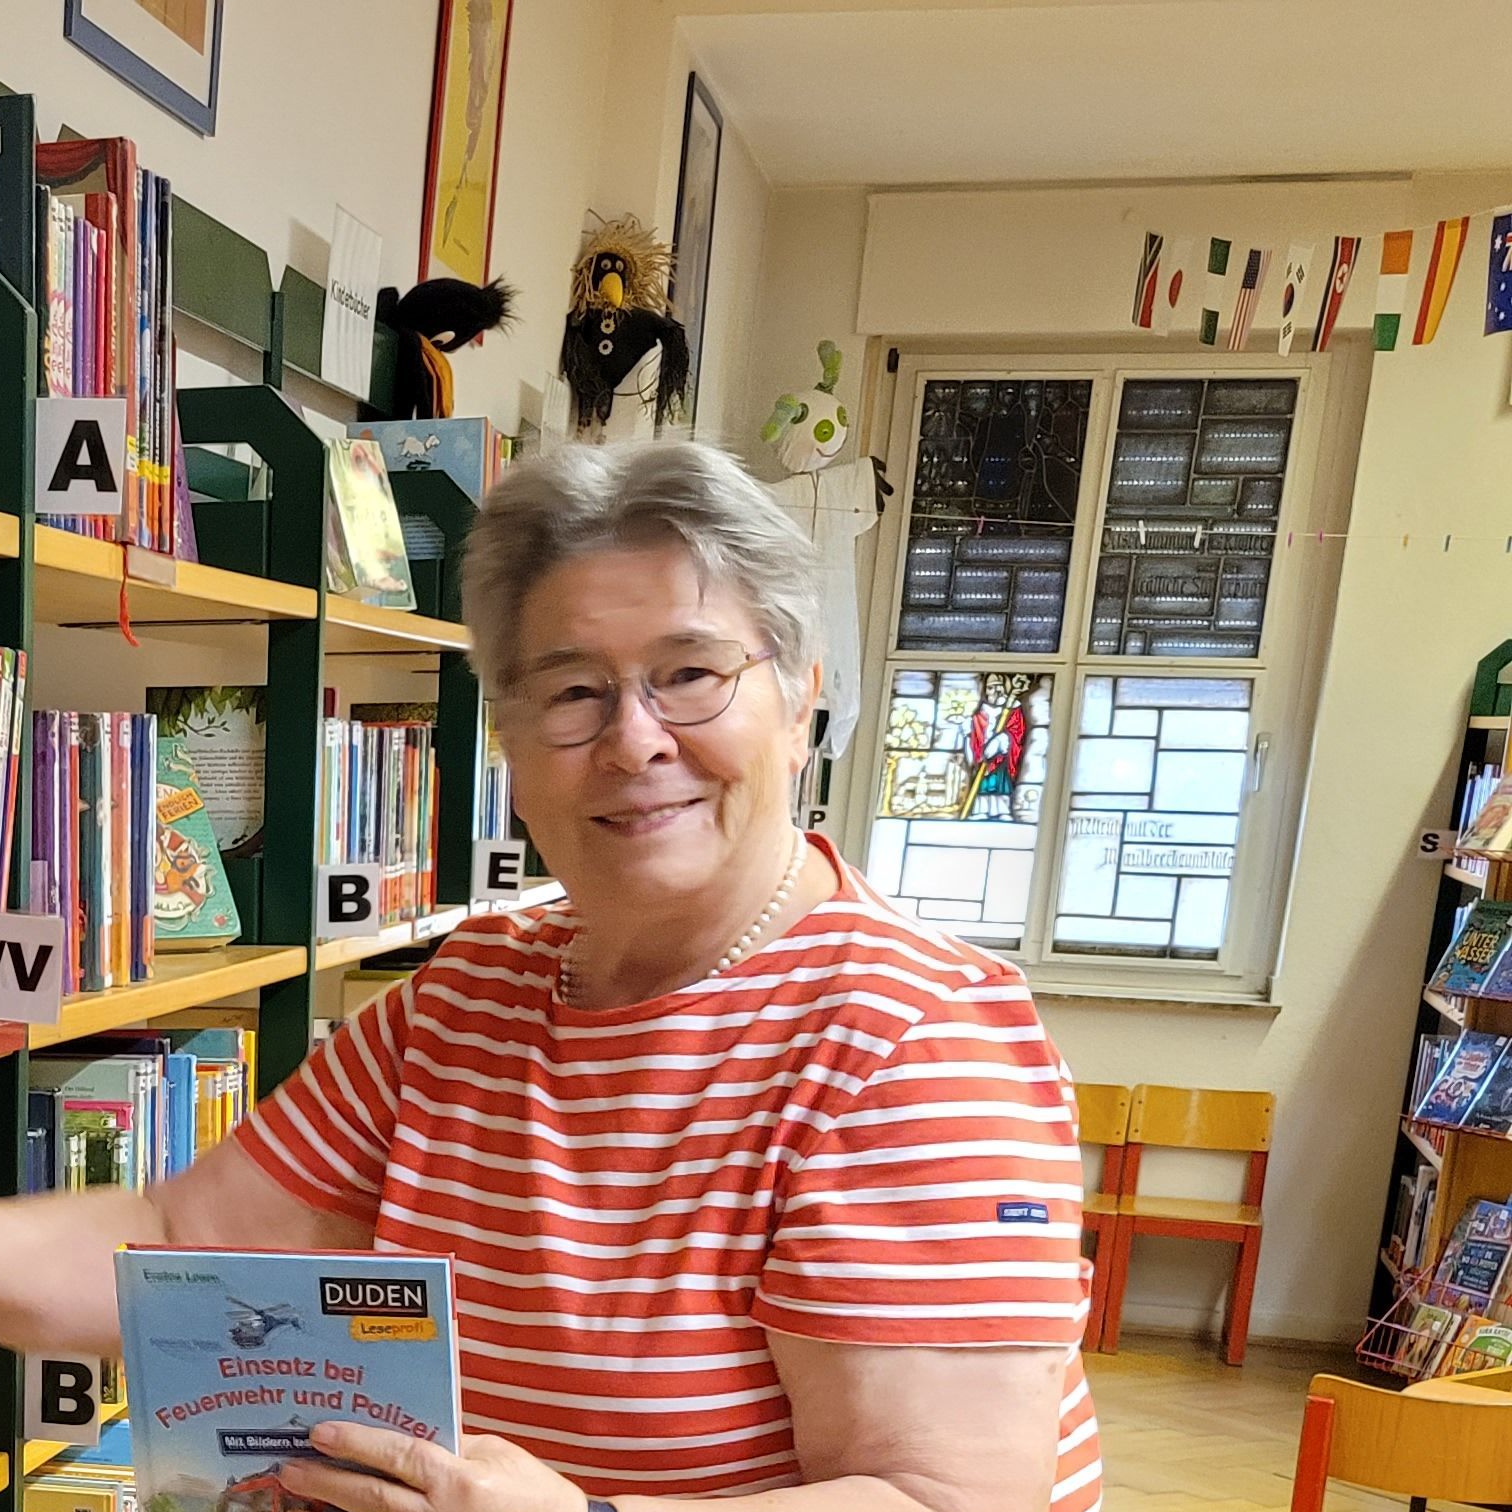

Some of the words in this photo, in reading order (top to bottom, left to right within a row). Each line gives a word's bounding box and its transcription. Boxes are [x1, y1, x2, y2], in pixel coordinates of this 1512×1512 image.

[330, 277, 372, 320] Kinderbücher
[47, 419, 118, 492] A
[808, 810, 826, 829] P
[1420, 833, 1441, 853] S
[488, 852, 519, 889] E
[328, 875, 371, 922] B
[1463, 931, 1500, 947] UNTER
[325, 1283, 423, 1307] DUDEN
[361, 1322, 425, 1336] Leseprofi
[217, 1357, 317, 1379] Einsatz
[324, 1359, 365, 1386] bei
[41, 1359, 97, 1427] B
[154, 1385, 286, 1429] Feuerwehr
[293, 1388, 343, 1410] und
[352, 1391, 440, 1442] Polizei
